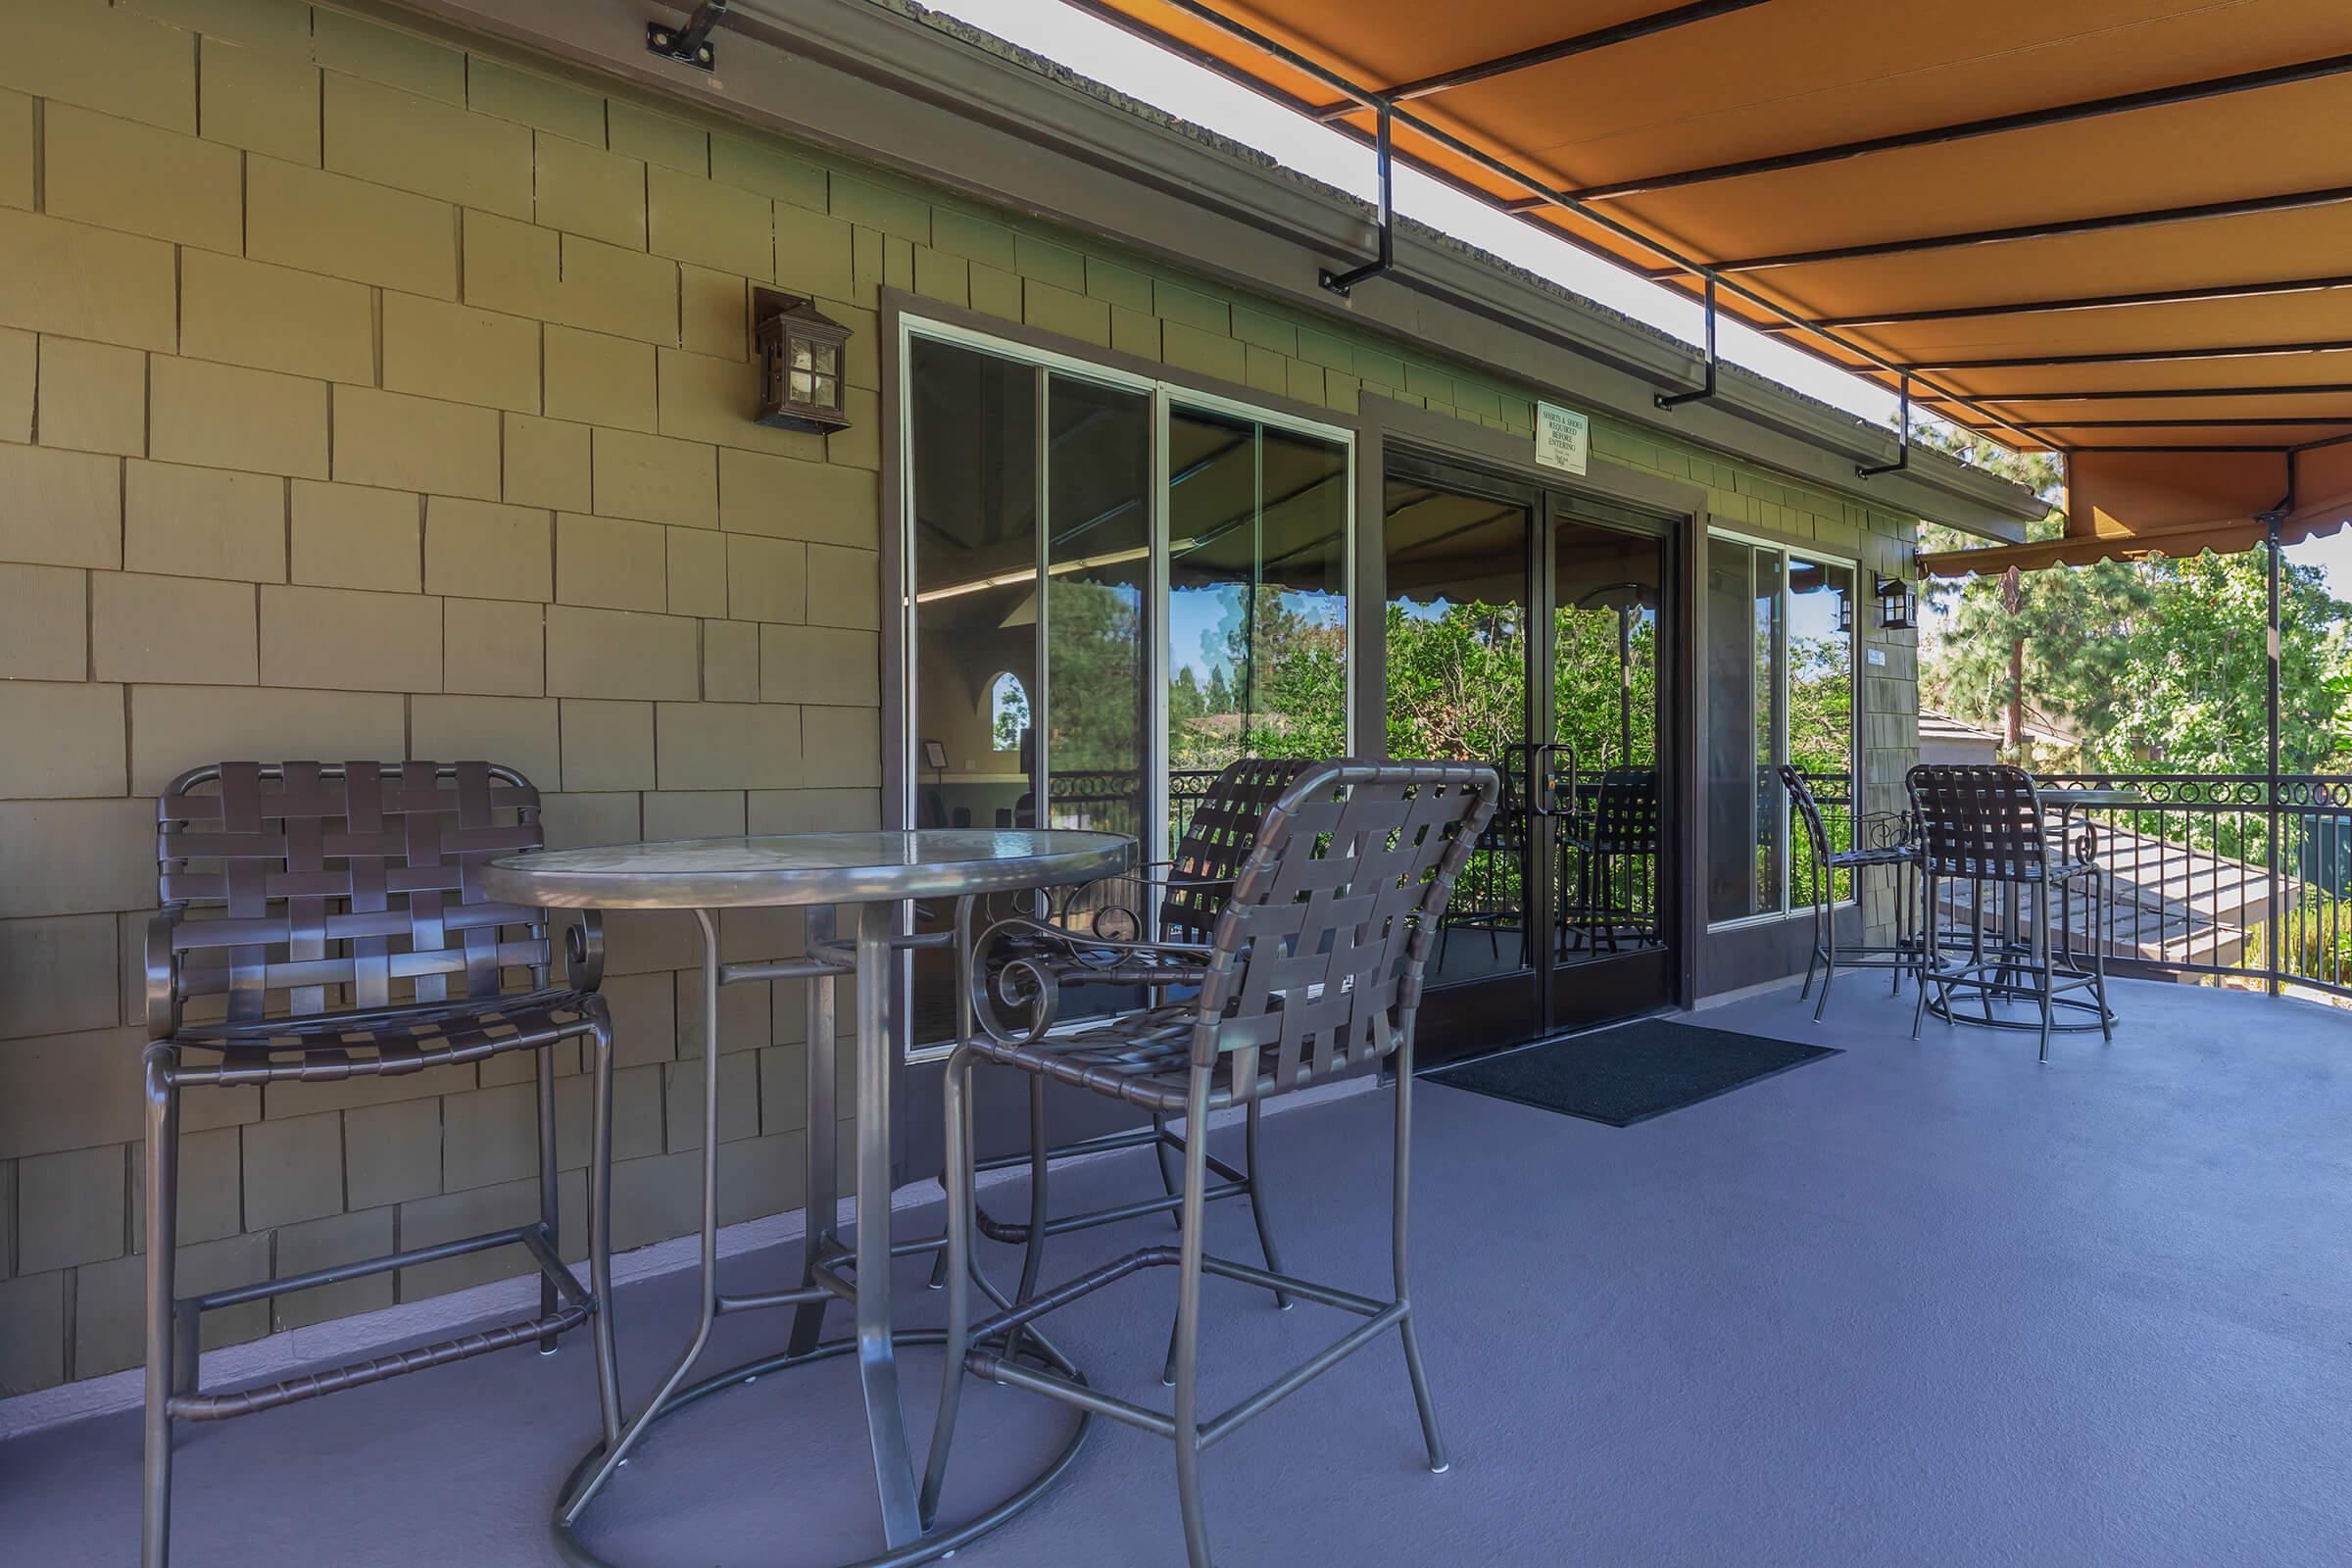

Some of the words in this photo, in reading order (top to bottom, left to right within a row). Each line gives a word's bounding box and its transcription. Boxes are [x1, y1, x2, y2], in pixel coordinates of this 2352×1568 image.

[1544, 412, 1561, 422] SHIRTS
[1567, 418, 1584, 429] SHOES
[1548, 421, 1578, 435] REQUIRED
[1552, 431, 1573, 443] BEFORE
[1548, 438, 1576, 452] ENTERING
